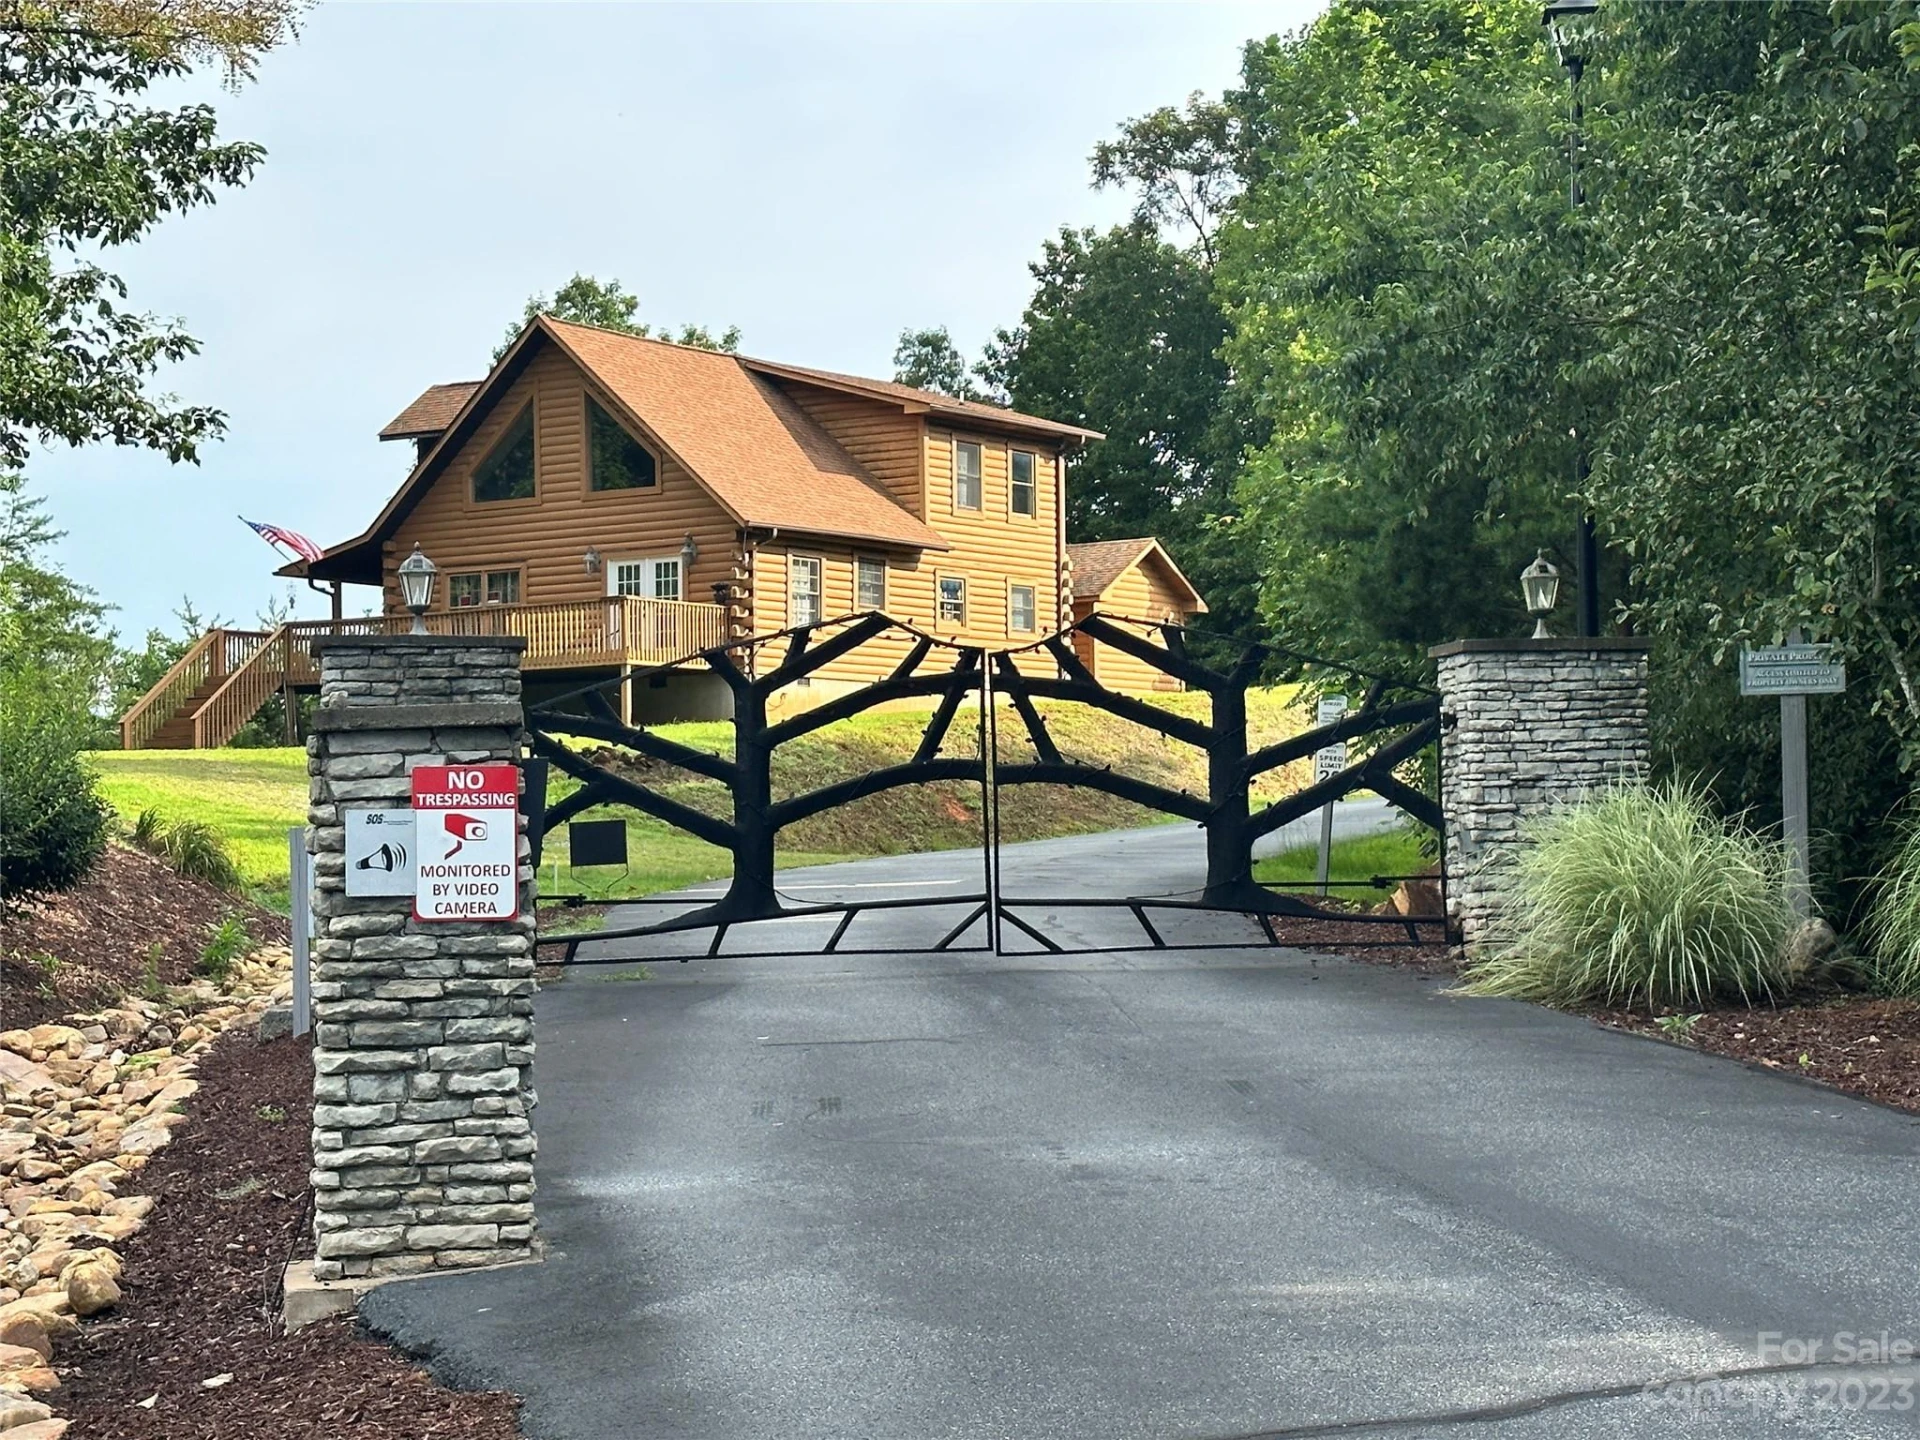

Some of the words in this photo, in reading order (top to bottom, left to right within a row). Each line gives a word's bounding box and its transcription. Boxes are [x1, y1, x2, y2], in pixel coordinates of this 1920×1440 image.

[448, 771, 485, 790] NO
[416, 793, 515, 806] TRESPASSING
[366, 813, 384, 825] SOS
[420, 865, 511, 878] MONITORED
[432, 884, 450, 896] BY
[454, 883, 499, 896] VIDEO
[434, 902, 498, 915] CAMERA
